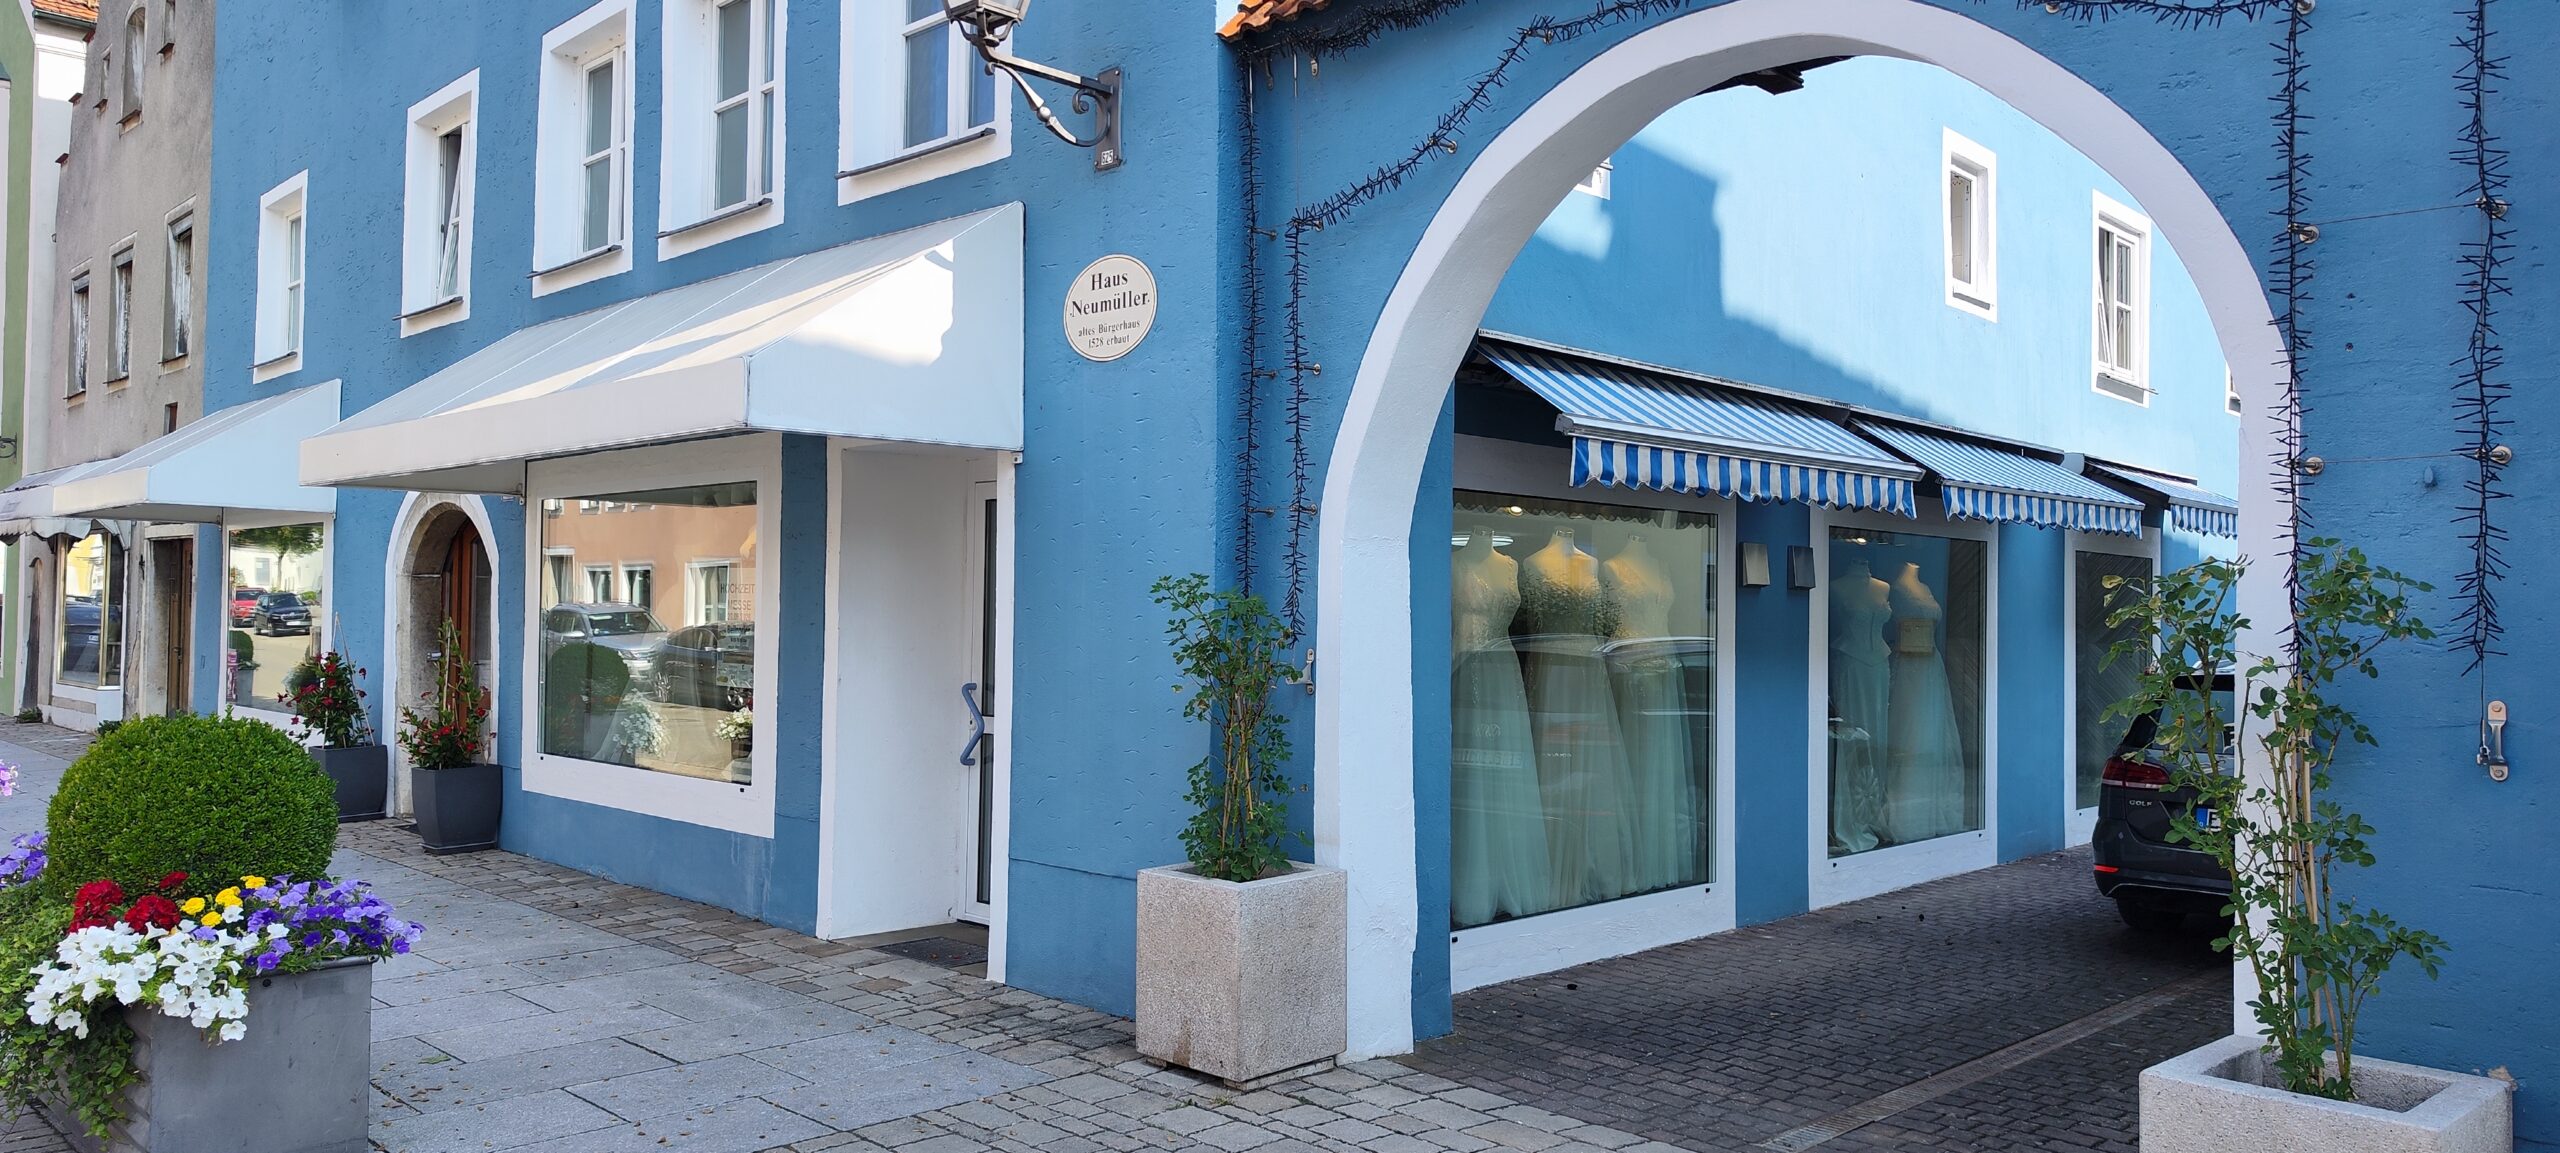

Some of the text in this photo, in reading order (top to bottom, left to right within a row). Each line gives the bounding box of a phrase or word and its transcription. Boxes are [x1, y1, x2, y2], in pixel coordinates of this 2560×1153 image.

[1091, 272, 1128, 291] Haus
[1078, 319, 1140, 337] altes Bürgerhaus
[1088, 334, 1130, 349] 1528 erbaut
[2129, 799, 2153, 807] GOLF
